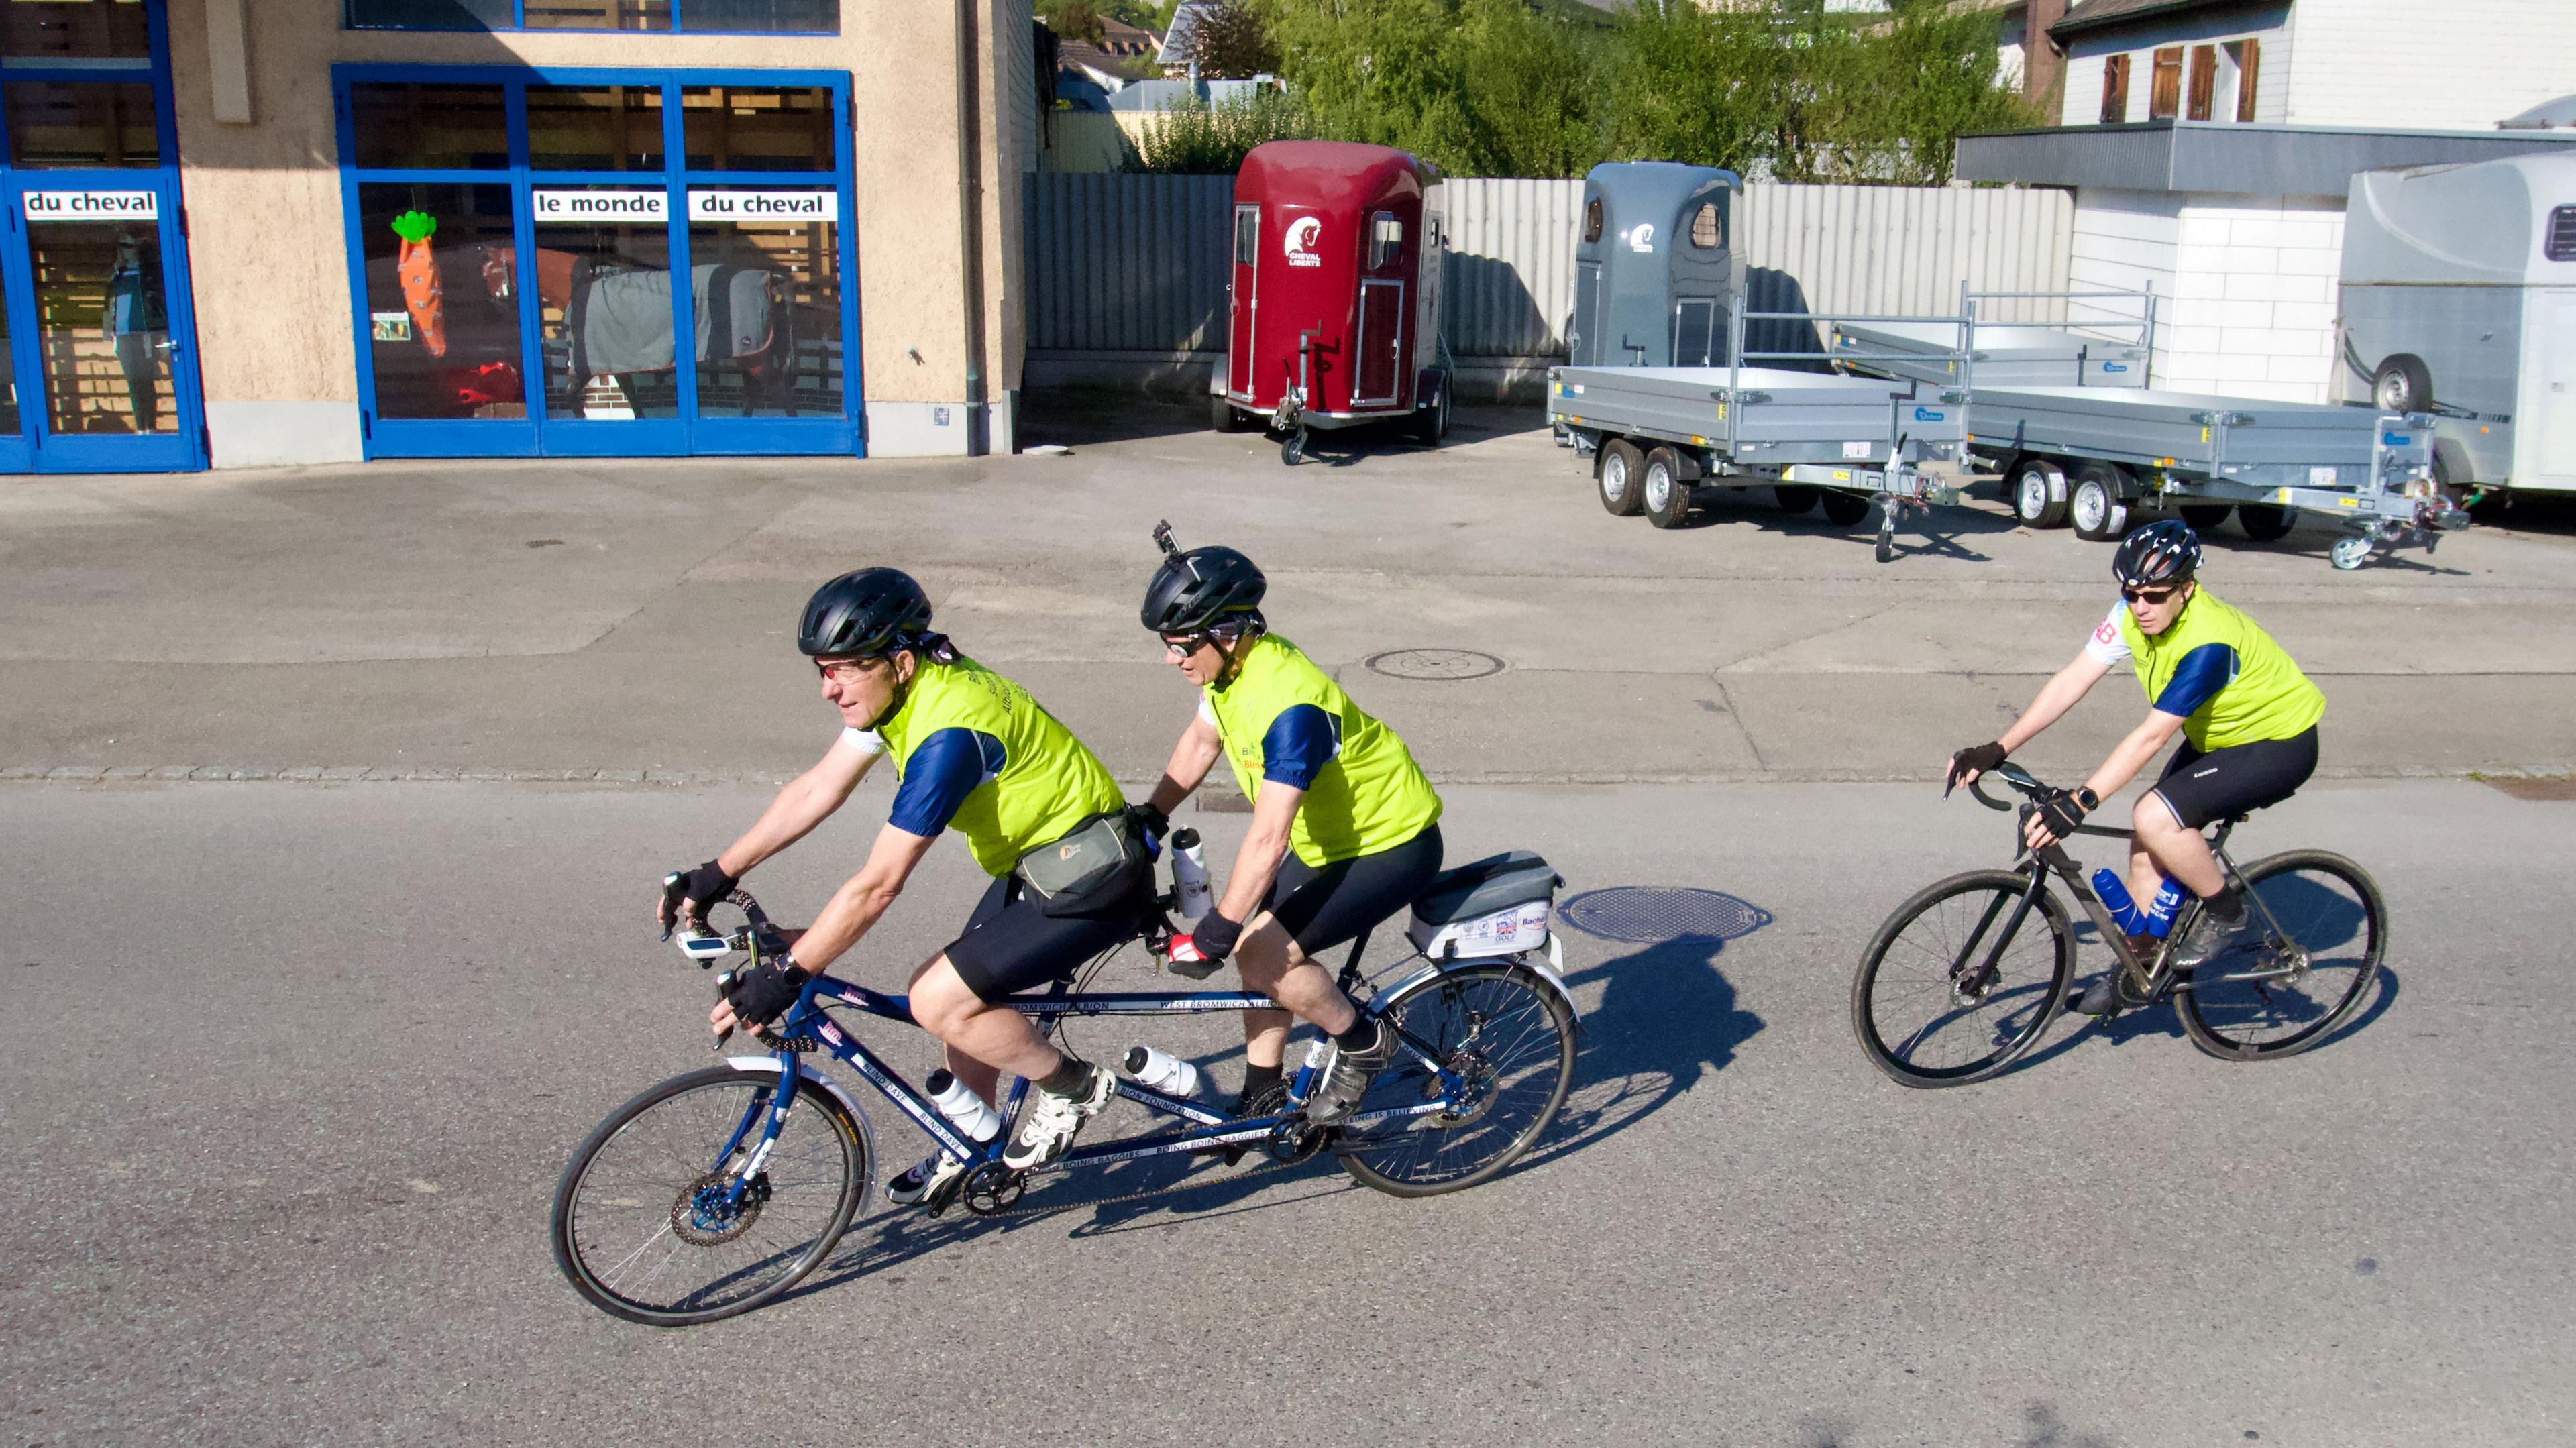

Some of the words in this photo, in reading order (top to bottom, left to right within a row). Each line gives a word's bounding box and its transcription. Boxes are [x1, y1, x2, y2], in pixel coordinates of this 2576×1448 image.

[29, 193, 61, 211] du
[71, 192, 154, 211] cheval
[539, 194, 560, 211] le
[572, 195, 660, 212] monde
[702, 194, 733, 212] du
[743, 195, 823, 212] cheval
[1289, 252, 1321, 260] CHEVAL
[863, 1063, 885, 1084] BLIND
[885, 1082, 907, 1103] DAVE
[1145, 1096, 1202, 1119] FOUNDATION
[1375, 1110, 1383, 1118] IS
[1386, 1105, 1436, 1117] BELIEVING
[919, 1112, 942, 1133] BLIND
[941, 1131, 962, 1150] DAVE
[1157, 1144, 1187, 1154] BOING
[1225, 1131, 1266, 1143] BAGGIES
[1063, 1160, 1095, 1170] BOING
[1098, 1150, 1141, 1164] BAGGIES
